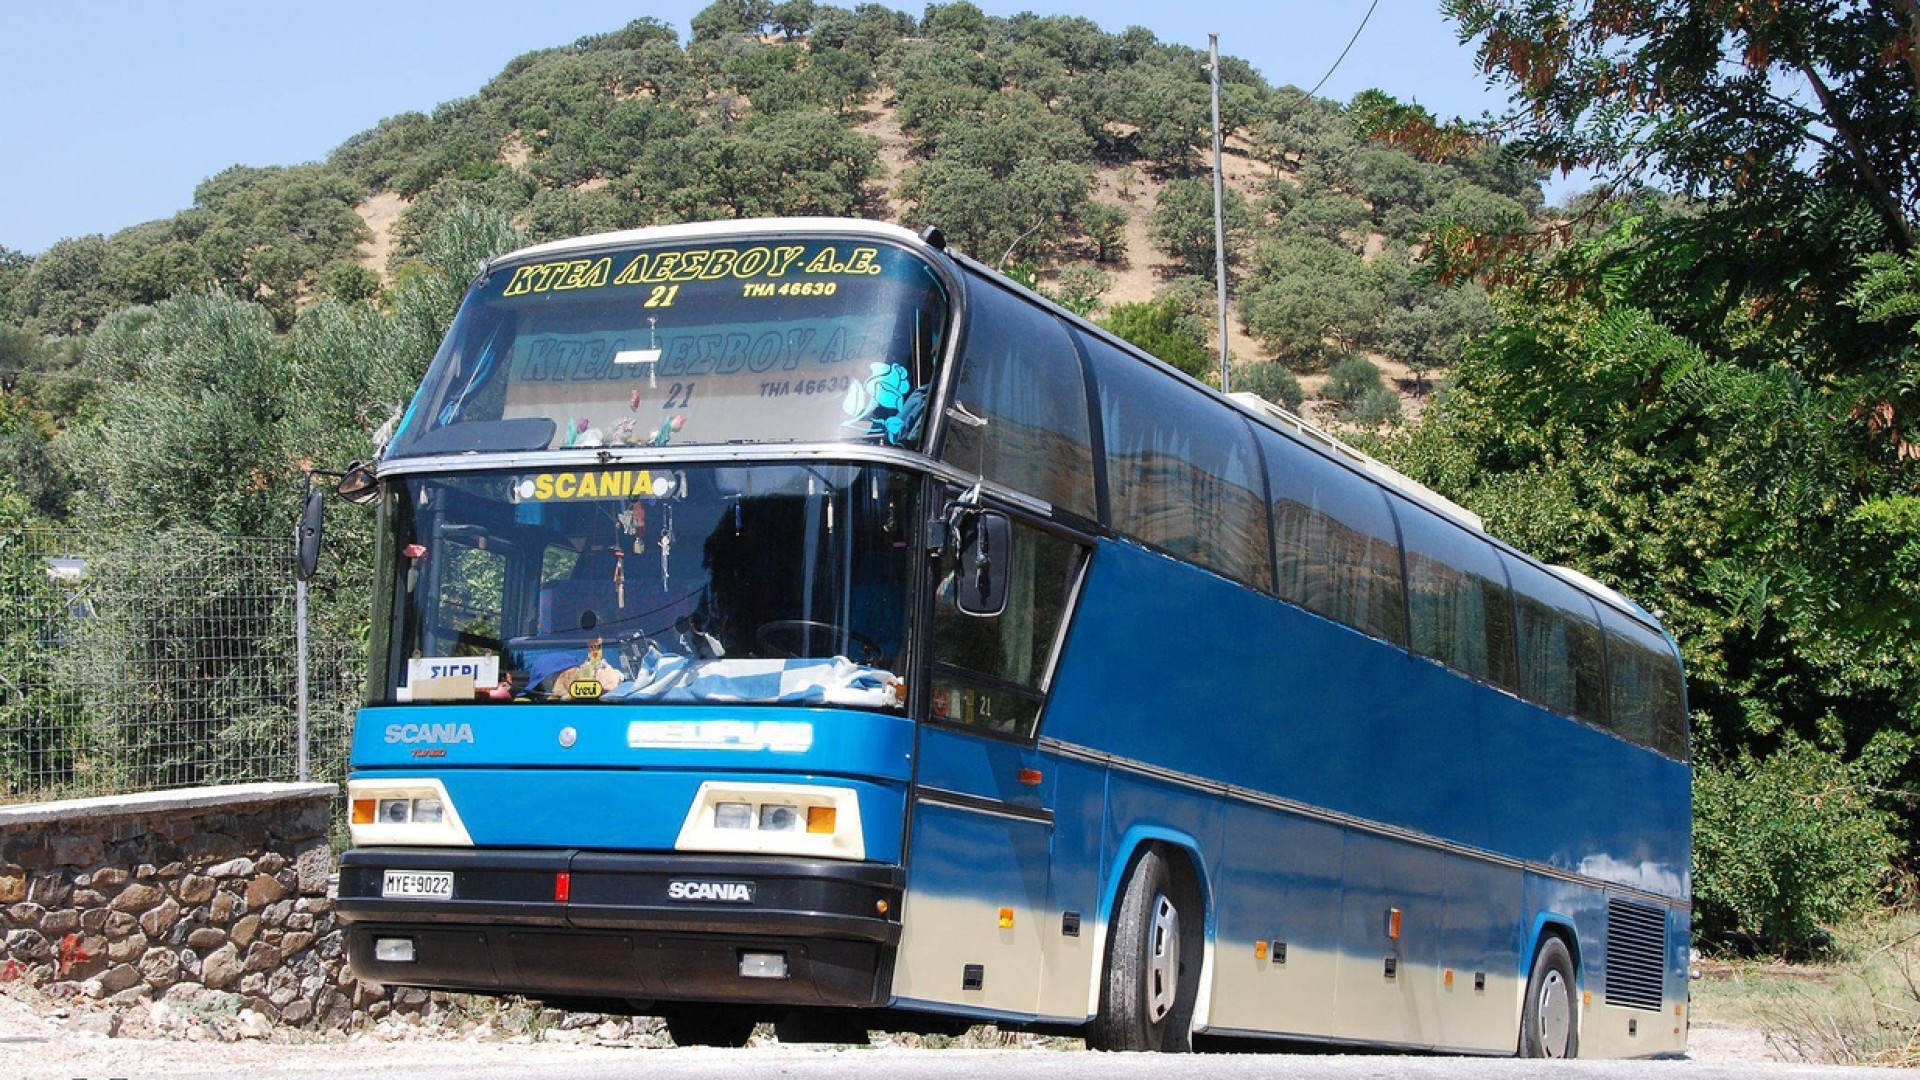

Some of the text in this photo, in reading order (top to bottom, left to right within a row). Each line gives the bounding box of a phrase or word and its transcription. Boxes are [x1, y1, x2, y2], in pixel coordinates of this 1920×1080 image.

[643, 285, 679, 309] 21
[779, 282, 837, 296] 46630
[535, 470, 653, 499] SCANIA
[980, 695, 991, 716] 21
[384, 723, 473, 743] SCANIA
[668, 882, 751, 901] SCANIA
